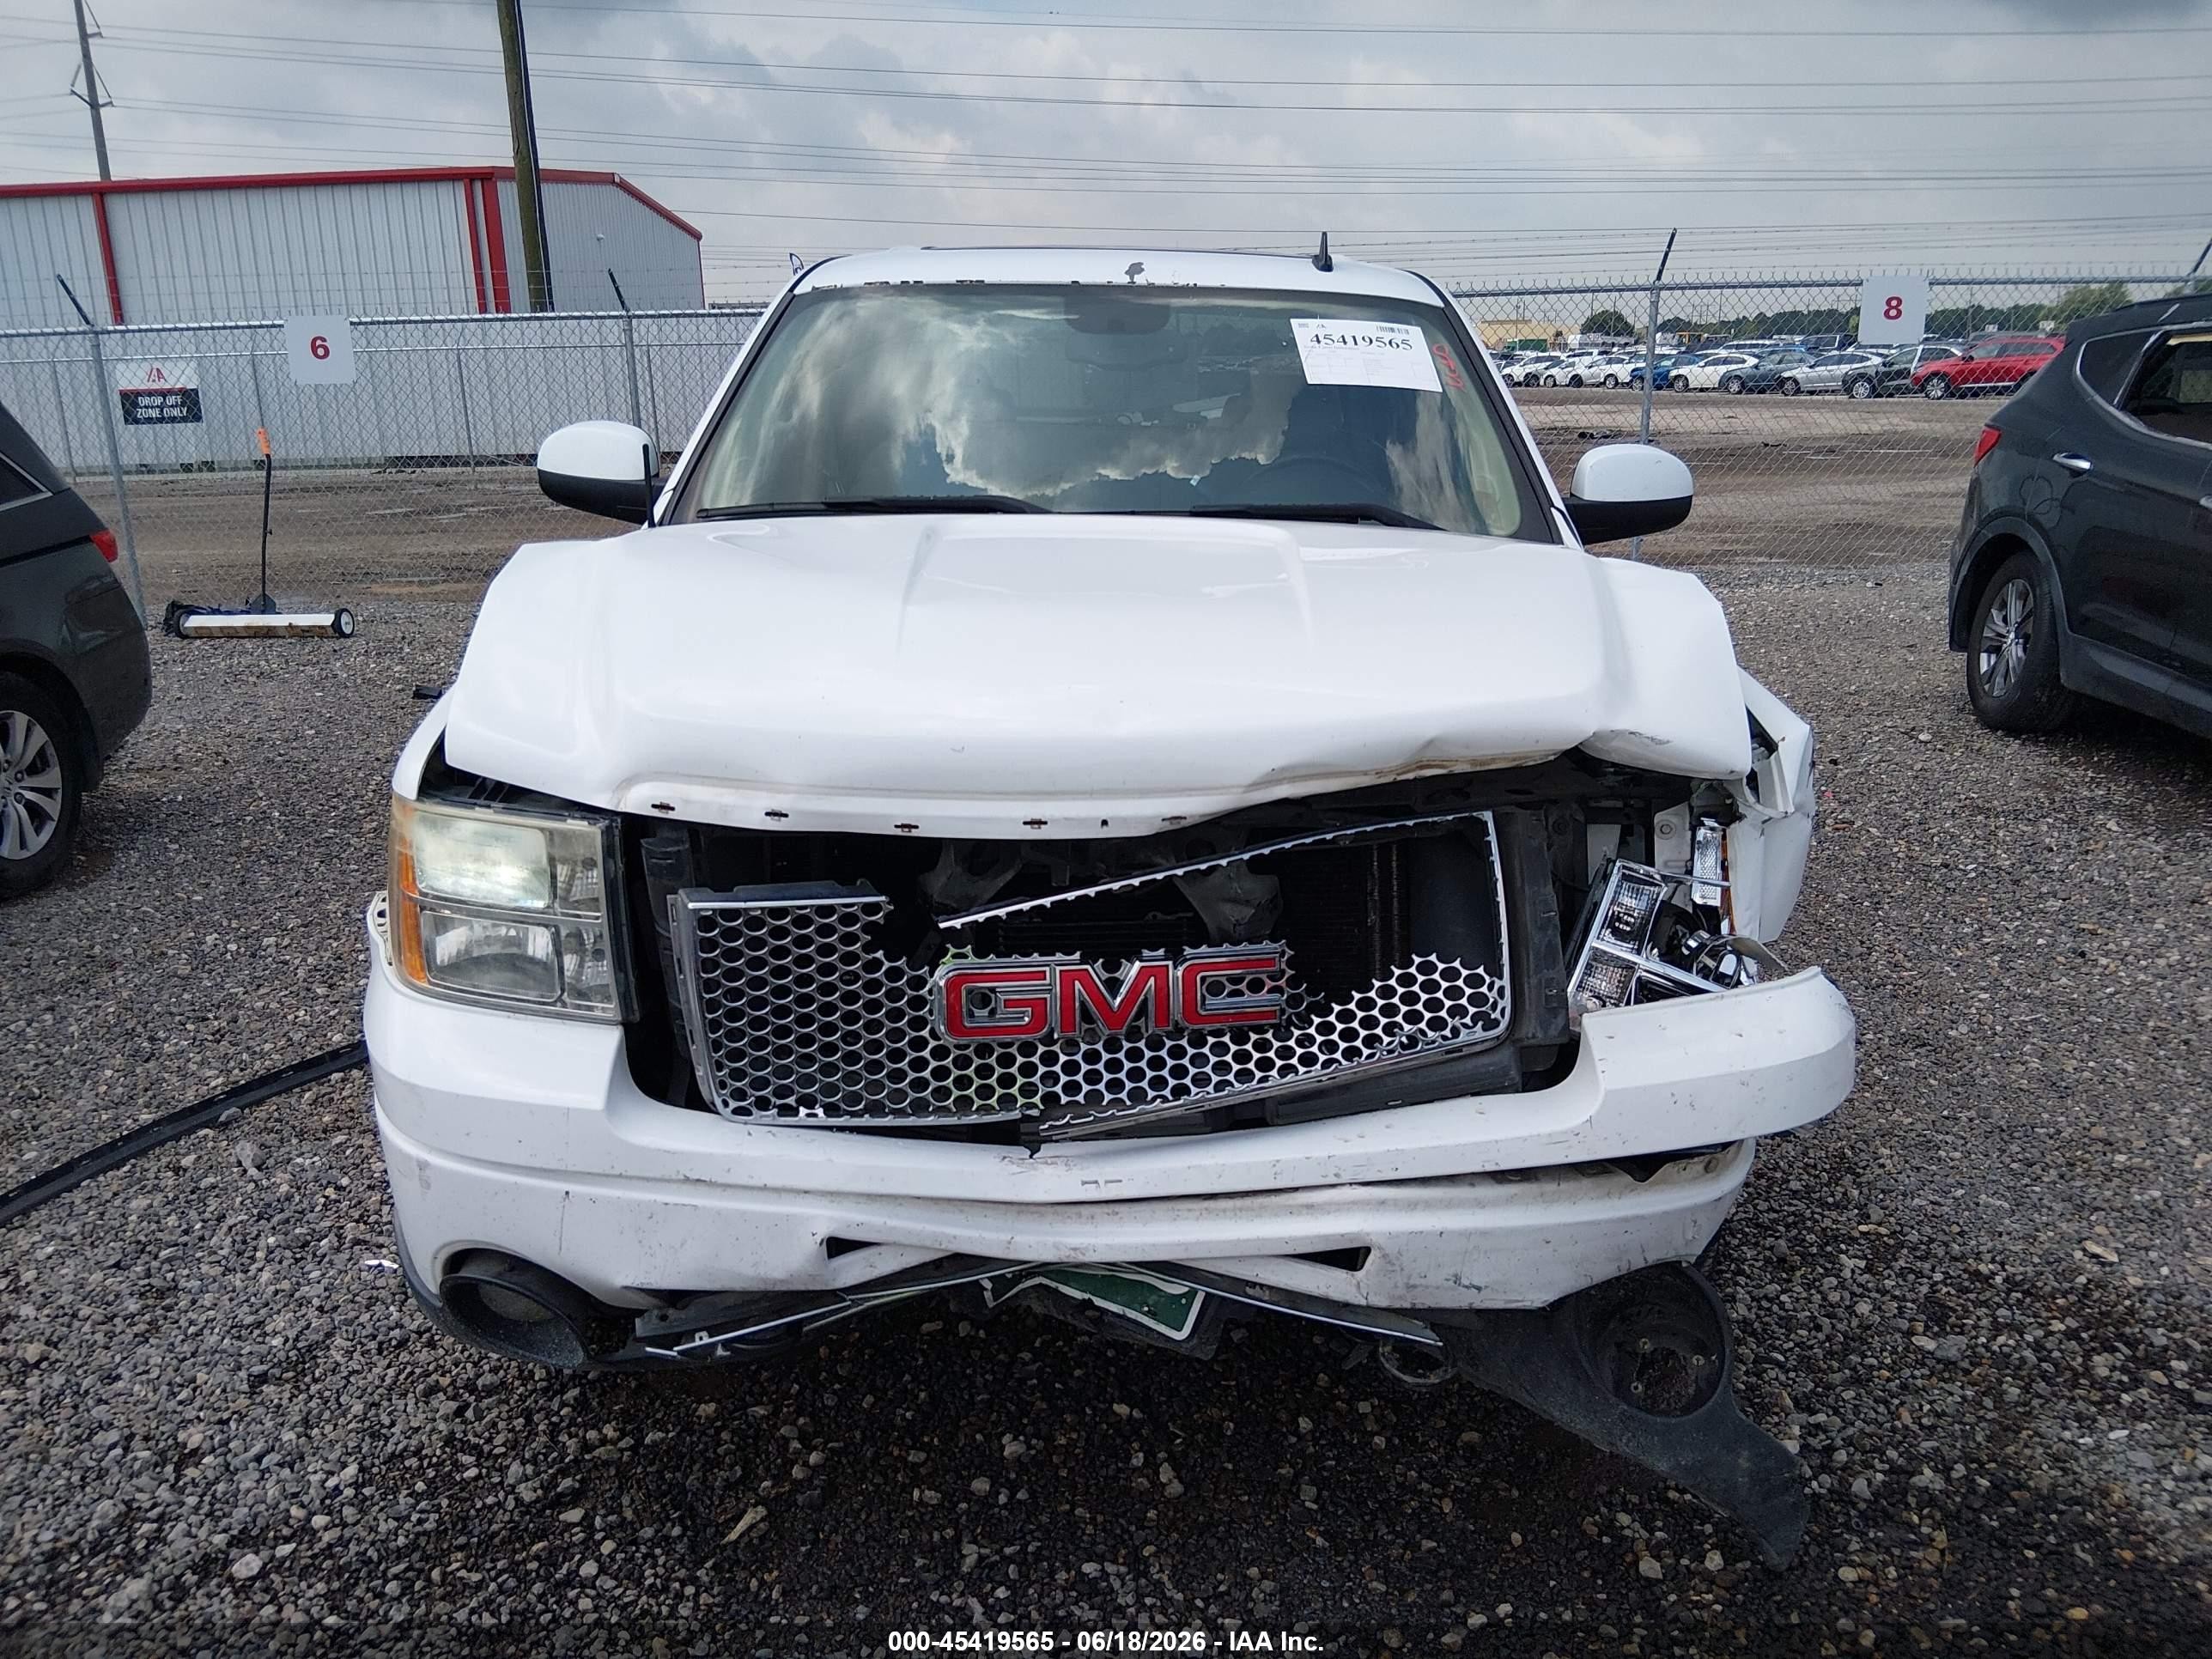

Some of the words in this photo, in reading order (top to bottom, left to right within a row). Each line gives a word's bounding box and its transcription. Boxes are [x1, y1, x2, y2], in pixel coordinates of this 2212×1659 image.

[1883, 296, 1903, 320] 8
[310, 335, 331, 360] 6
[1310, 332, 1413, 351] 45419565
[138, 396, 164, 407] DROP
[166, 395, 183, 405] OFF
[137, 408, 162, 419] ZONE
[163, 406, 188, 417] ONLY
[941, 951, 1283, 1041] GMC
